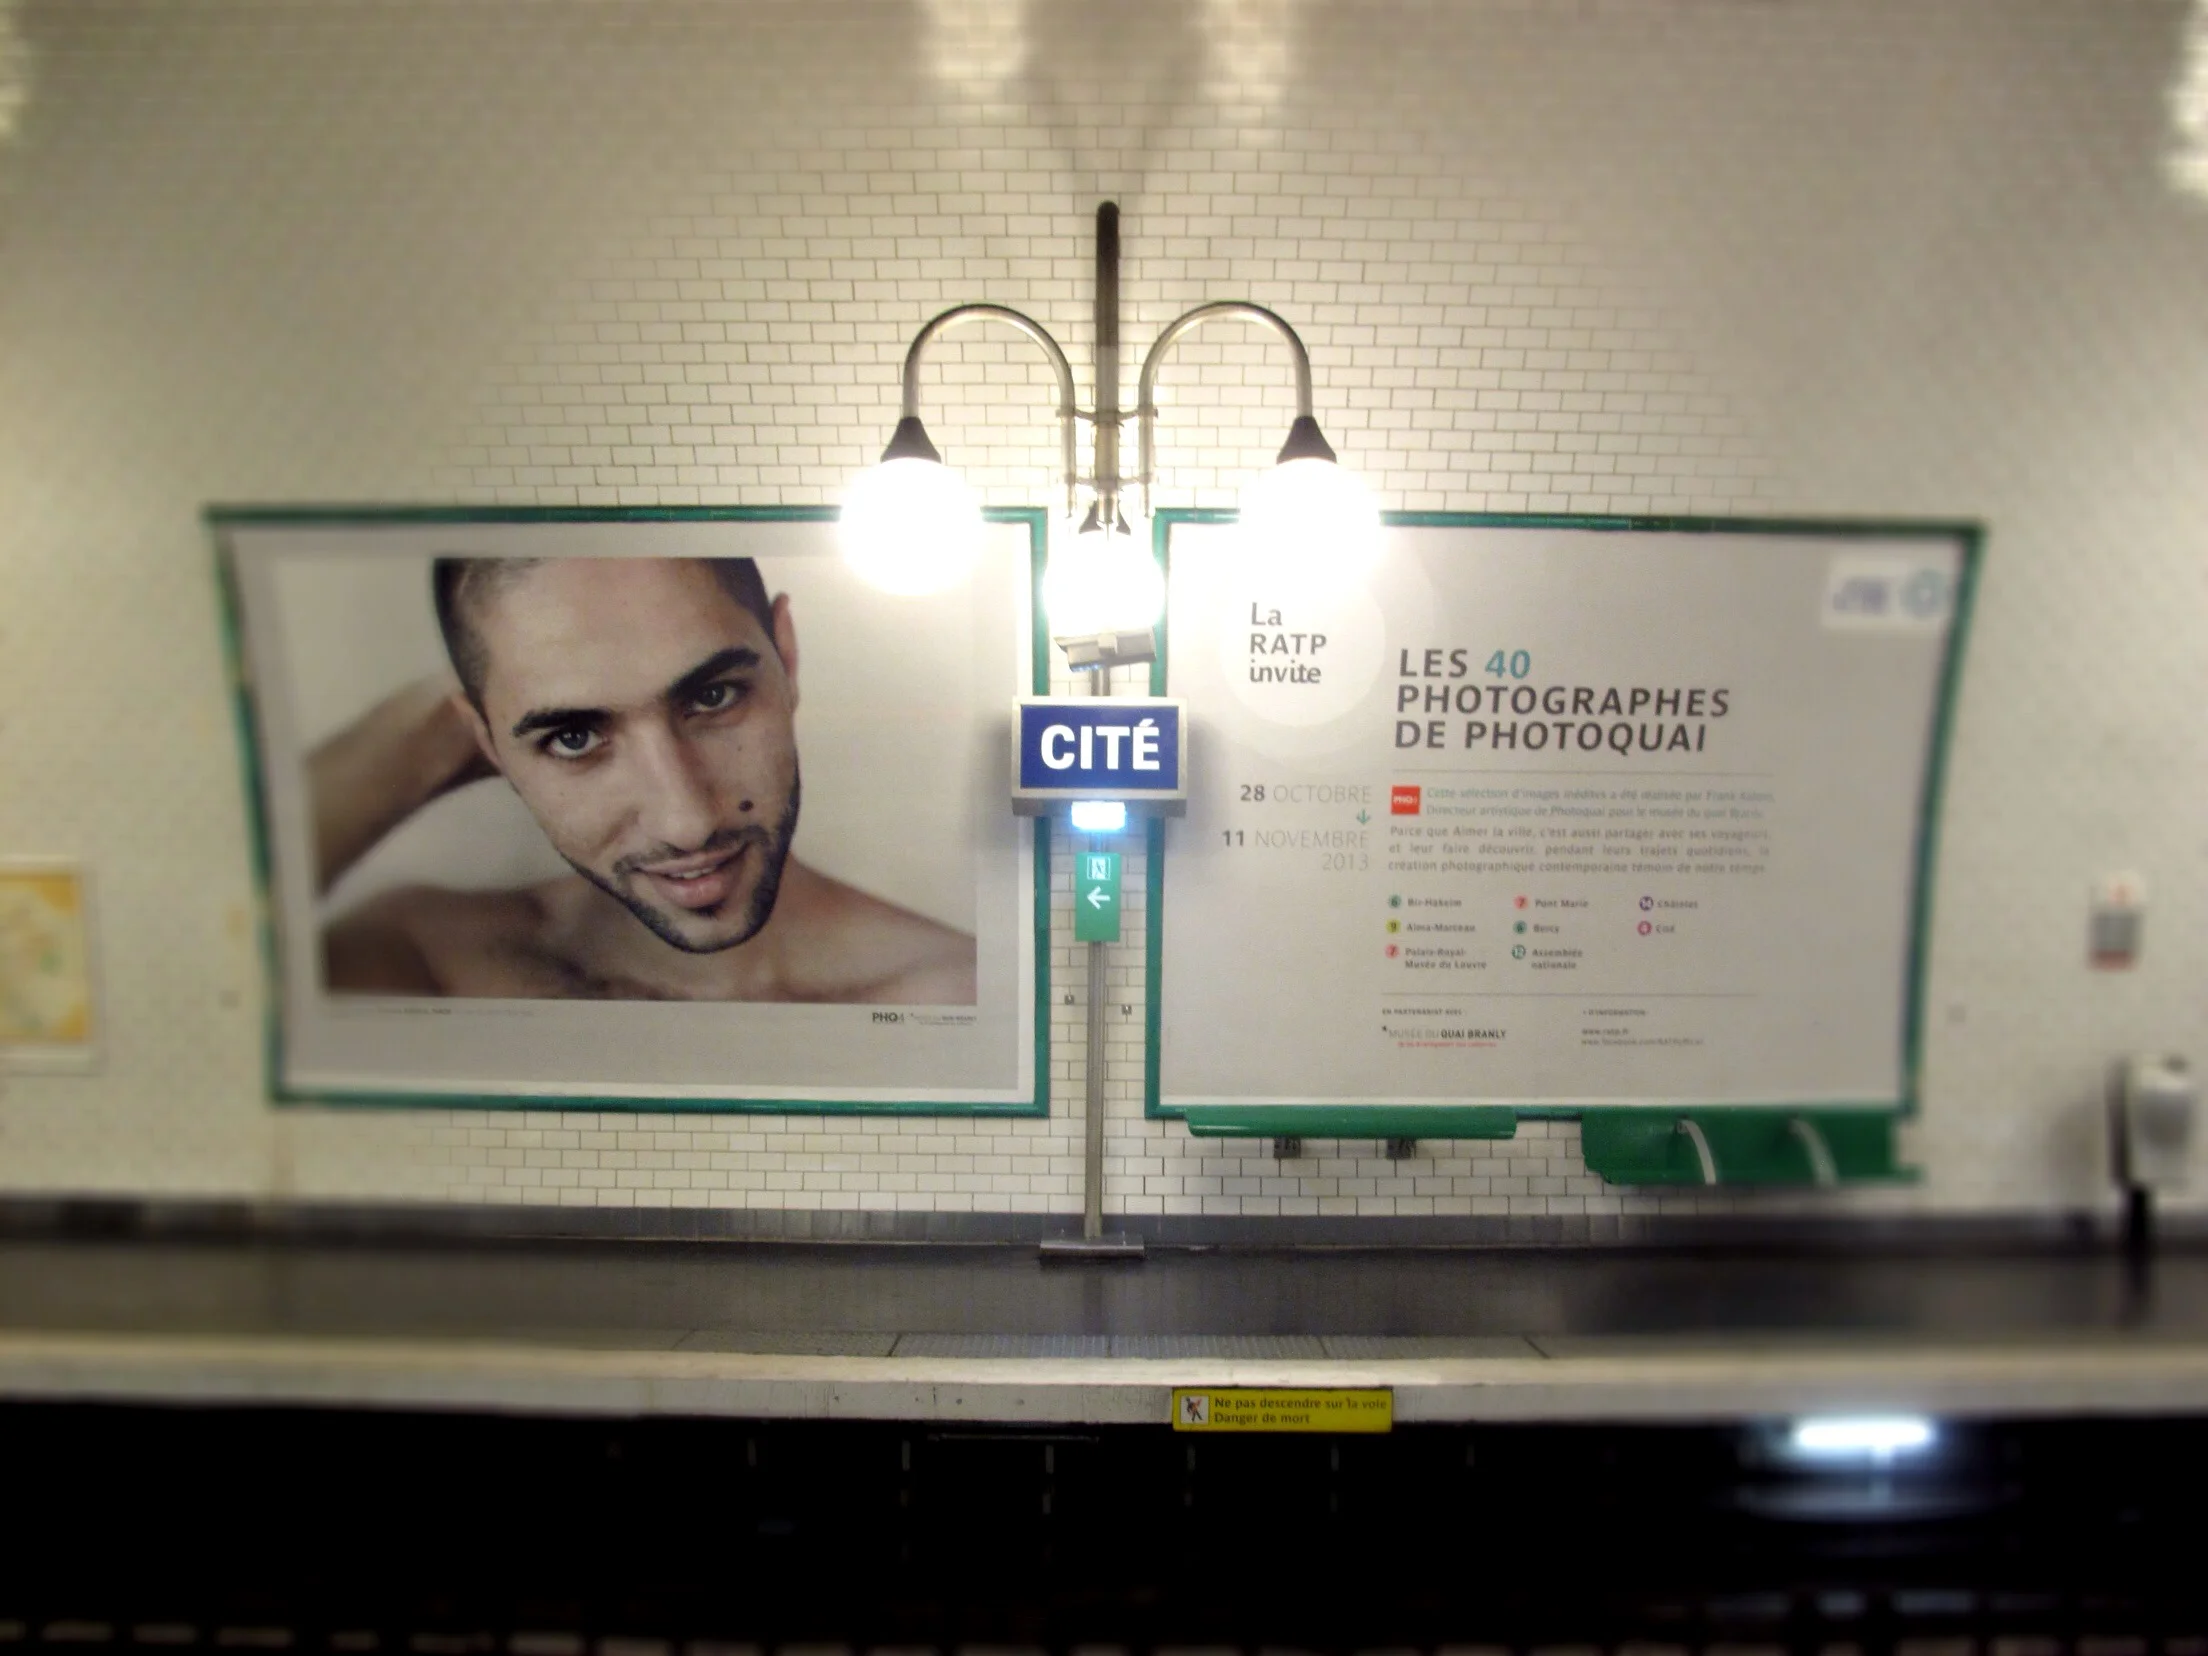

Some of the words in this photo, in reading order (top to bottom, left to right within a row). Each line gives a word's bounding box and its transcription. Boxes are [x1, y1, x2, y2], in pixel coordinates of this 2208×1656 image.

[1251, 601, 1282, 626] La
[1250, 632, 1327, 655] RATP
[1250, 659, 1322, 684] invite
[1399, 648, 1468, 678] LES
[1484, 649, 1531, 679] 40
[1396, 684, 1730, 717] PHOTOGRAPHES
[1041, 718, 1160, 771] CITÉ
[1395, 720, 1446, 749] DE
[1464, 721, 1706, 756] PHOTOQUAI
[1240, 784, 1265, 802] 28
[1273, 785, 1372, 804] OCTOBRE
[1222, 829, 1245, 848] 11
[1255, 830, 1370, 849] NOVEMBRE
[1390, 825, 1422, 837] Parce
[1427, 827, 1449, 839] que
[1453, 826, 1488, 837] Aimer
[1389, 843, 1400, 854] et
[1443, 843, 1470, 854] faire
[1545, 844, 1593, 857] pendant
[1322, 853, 1370, 872] 2013
[1388, 860, 1437, 872] création
[1441, 860, 1536, 874] photographique
[1440, 1028, 1465, 1039] QUAI
[1467, 1028, 1506, 1039] BRANLY
[1214, 1397, 1231, 1409] Ne
[1235, 1400, 1256, 1411] pas
[1259, 1398, 1322, 1410] descendre
[1325, 1400, 1343, 1409] sur
[1362, 1398, 1387, 1410] voie
[1214, 1412, 1257, 1425] Danger
[1262, 1412, 1276, 1424] de
[1280, 1414, 1310, 1425] mort
